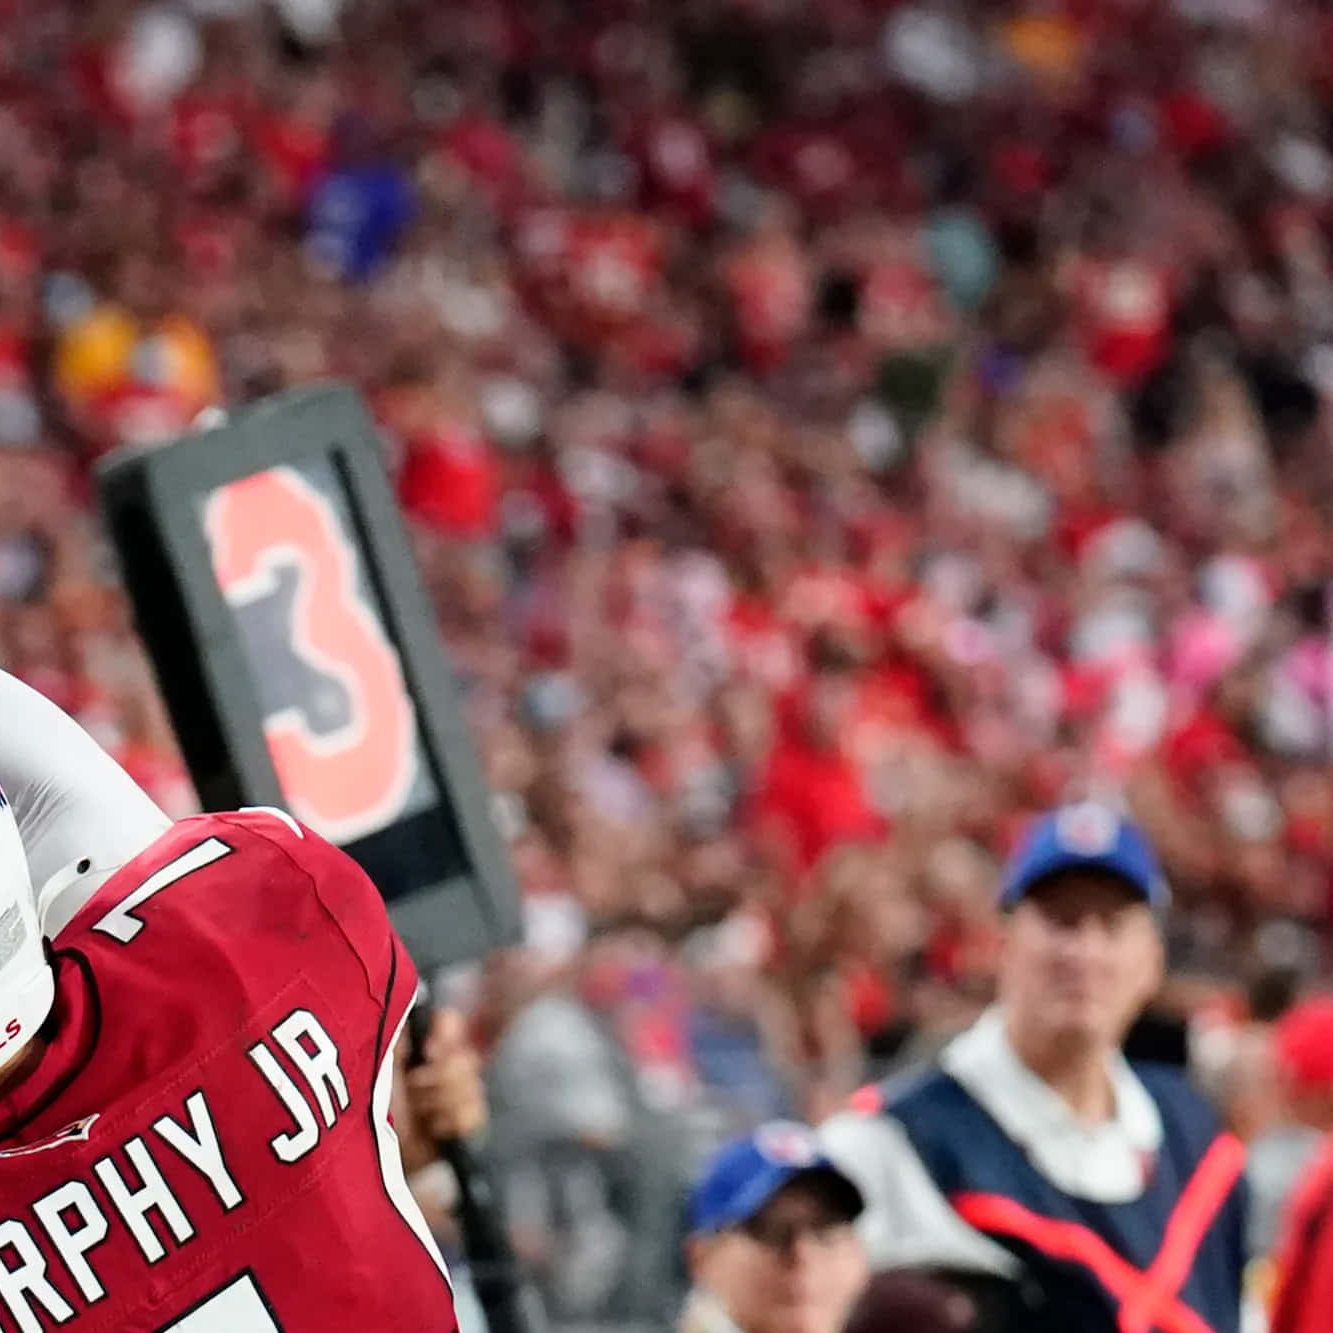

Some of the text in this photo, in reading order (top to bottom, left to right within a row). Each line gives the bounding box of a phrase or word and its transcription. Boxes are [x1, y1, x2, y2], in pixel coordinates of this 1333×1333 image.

[204, 466, 418, 846] 3
[91, 836, 234, 944] 7
[246, 1007, 352, 1166] JR
